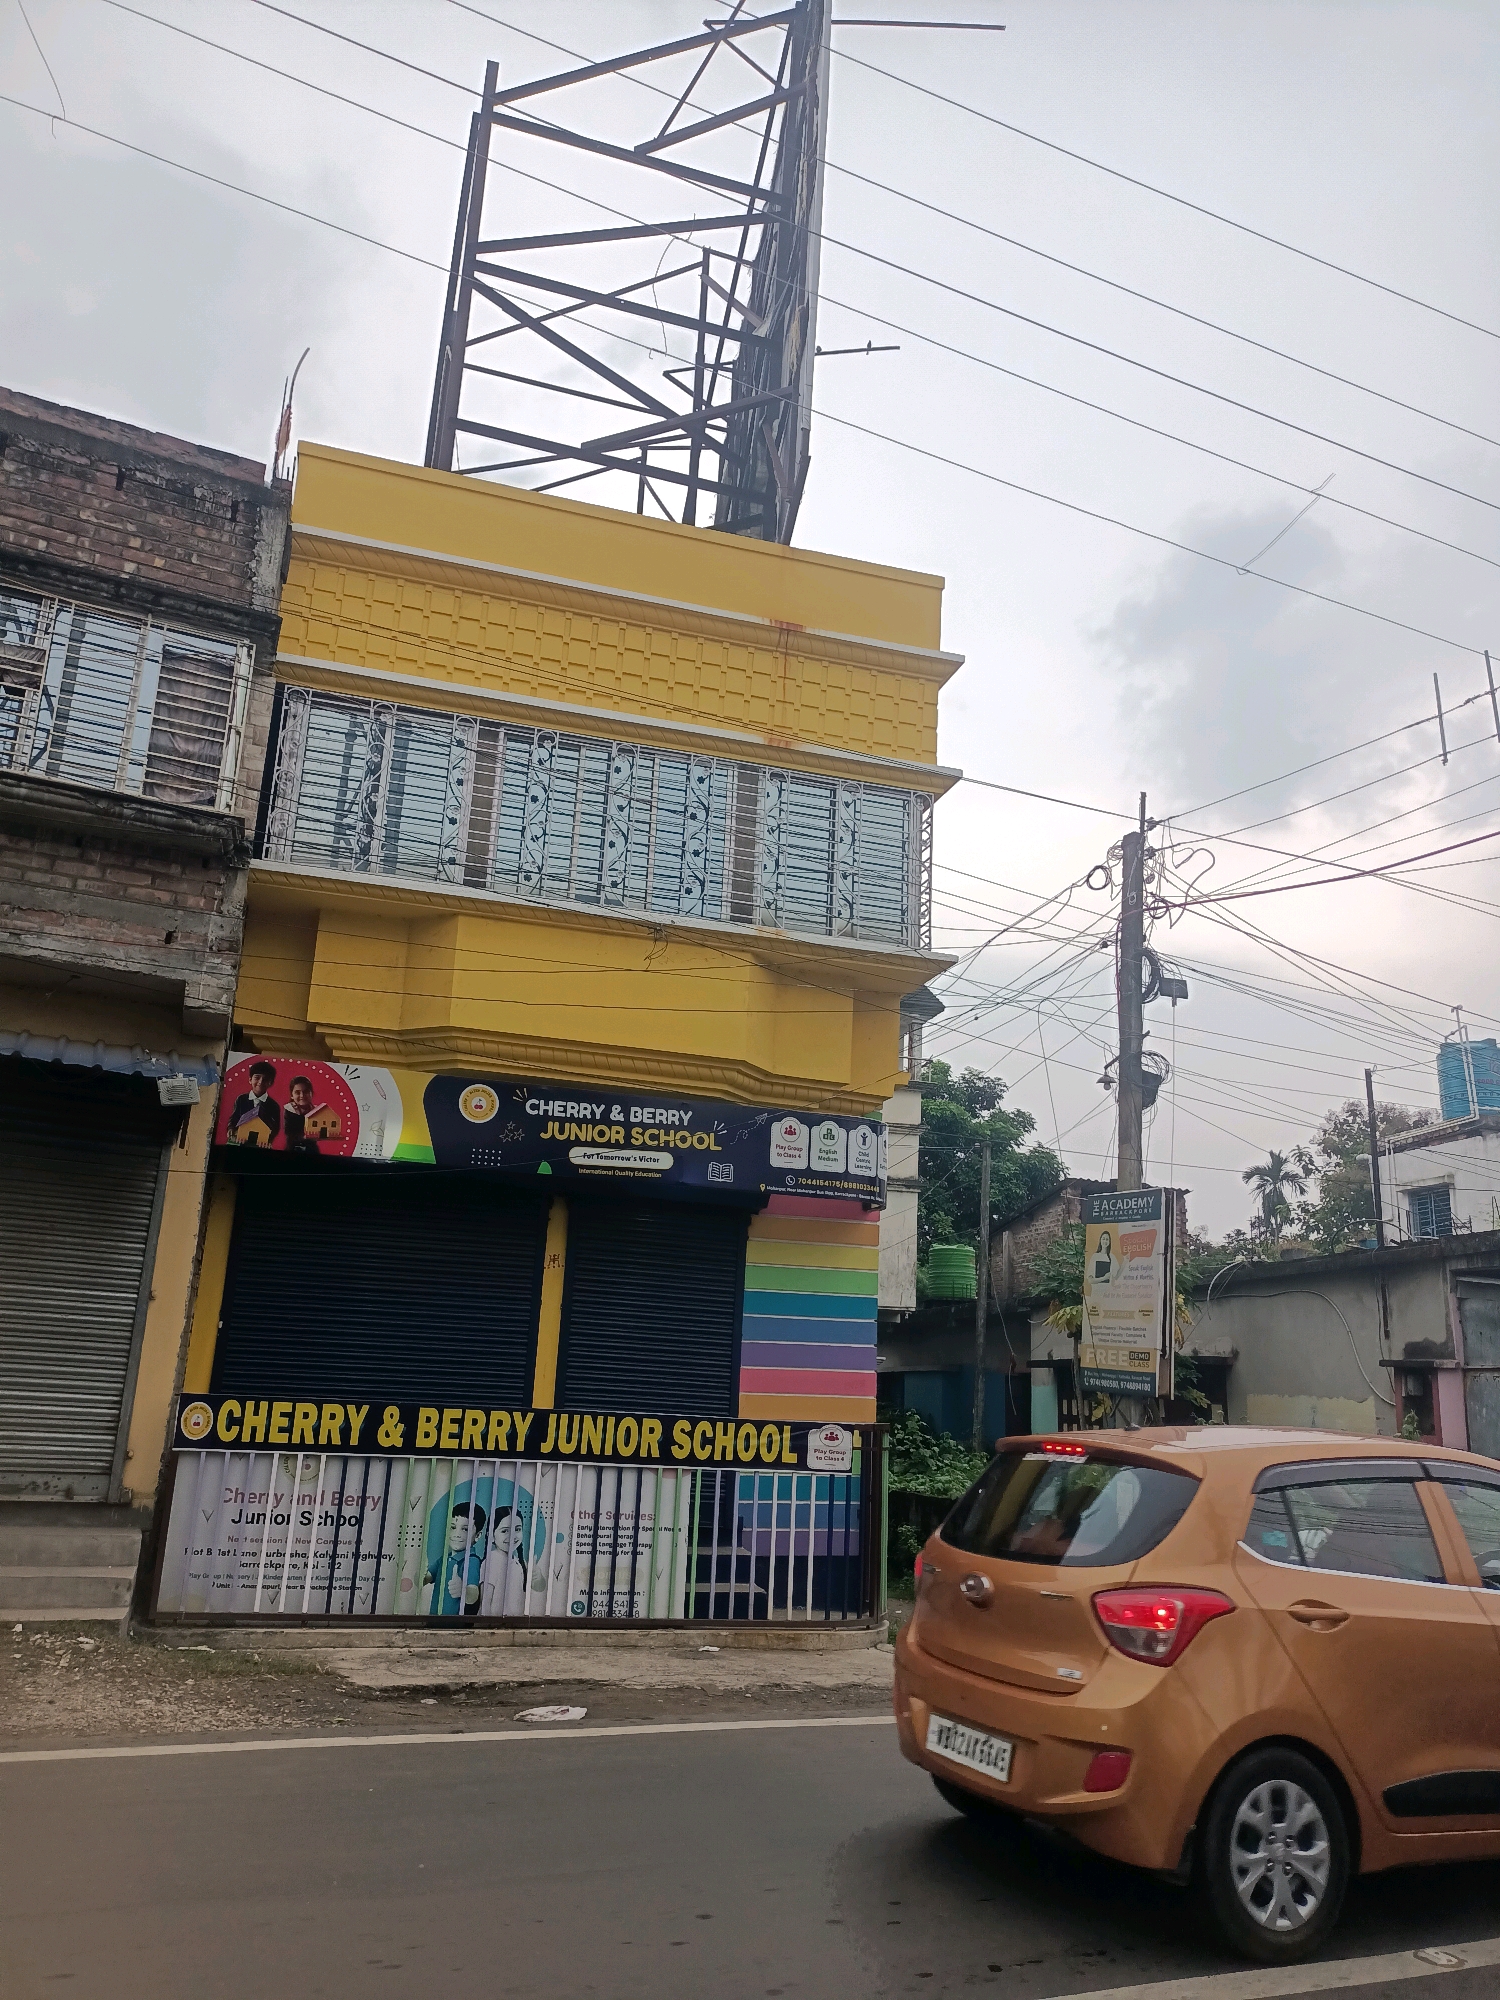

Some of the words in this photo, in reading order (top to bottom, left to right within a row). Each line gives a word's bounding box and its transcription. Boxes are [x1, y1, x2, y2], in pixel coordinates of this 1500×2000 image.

[525, 1098, 606, 1120] CHERRY
[609, 1104, 625, 1121] &
[629, 1106, 693, 1126] BERRY
[539, 1121, 625, 1144] JUNIOR
[631, 1127, 723, 1151] SCHOOL
[775, 1144, 786, 1152] Play
[787, 1145, 803, 1153] Group
[818, 1147, 838, 1155] English
[595, 1153, 637, 1162] Tomorrow's
[638, 1155, 660, 1163] Victor
[578, 1168, 614, 1176] International
[1092, 1199, 1100, 1217] THE
[1101, 1195, 1155, 1211] ACADEMY
[1123, 1243, 1152, 1253] ENGLISH
[1086, 1348, 1128, 1366] FREE
[1130, 1352, 1149, 1360] DEMO
[216, 1399, 370, 1445] CHERRY
[377, 1405, 404, 1448] &
[415, 1407, 534, 1452] BERRY
[540, 1413, 663, 1459] JUNIOR
[670, 1419, 798, 1464] SCHOOL
[299, 1510, 361, 1527] Schoo
[577, 1524, 593, 1532] Early
[227, 1535, 248, 1543] Net
[202, 1572, 222, 1580] Grup
